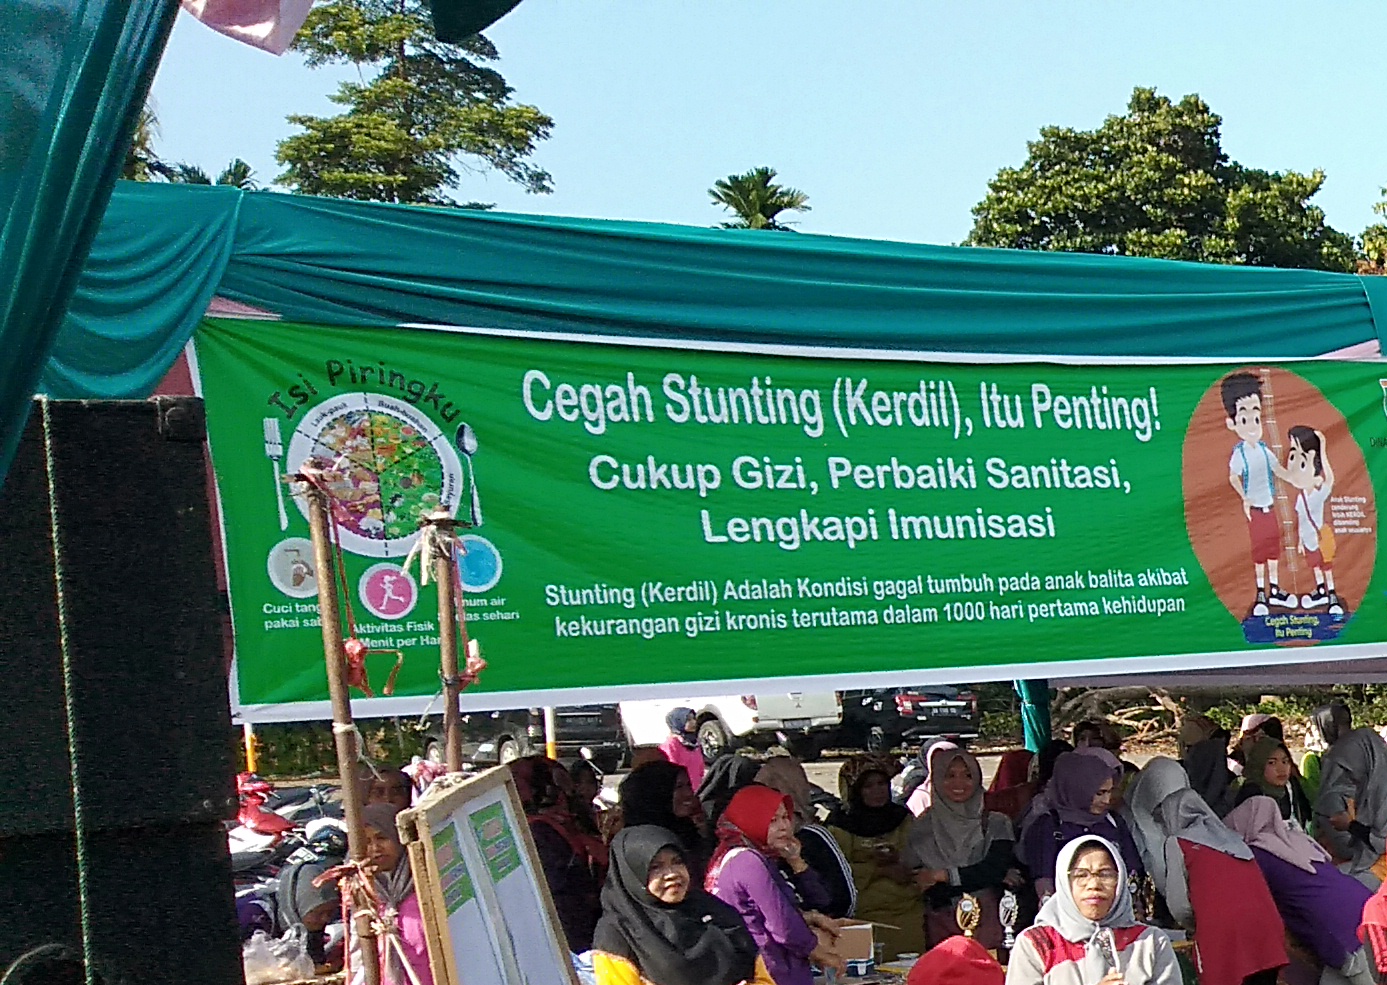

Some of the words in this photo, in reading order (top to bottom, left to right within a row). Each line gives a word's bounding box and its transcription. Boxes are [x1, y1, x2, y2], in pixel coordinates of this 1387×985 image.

[268, 374, 319, 420] Isi
[325, 359, 461, 423] Piringku
[522, 370, 655, 434] Cegah
[662, 373, 824, 438] Stunting
[833, 377, 974, 439] (Kerdil),
[980, 381, 1025, 428] Itu
[1031, 383, 1161, 442] Penting!
[588, 455, 721, 497] Cukup
[732, 456, 819, 495] Gizi,
[827, 456, 977, 489] Perbaiki
[985, 457, 1131, 494] Sanitasi,
[700, 509, 879, 550] Lengkapi
[888, 507, 1056, 541] Imunisasi
[490, 596, 507, 606] air
[545, 583, 635, 609] Stunting
[641, 580, 718, 607] (Kerdil)
[723, 578, 793, 601] Adalah
[797, 576, 868, 599] Kondisi
[873, 575, 923, 600] gagal
[927, 573, 994, 595] tumbuh
[999, 571, 1041, 596] pada
[1045, 570, 1085, 590] anak
[1088, 568, 1135, 589] balita
[1138, 567, 1189, 587] akibat
[263, 602, 293, 614] Cuci
[483, 609, 520, 621] sehari
[555, 615, 680, 639] kekurangan
[685, 611, 721, 637] gizi
[726, 609, 788, 632] kronis
[792, 606, 880, 628] terutama
[883, 603, 938, 625] dalam
[943, 601, 986, 622] 1000
[989, 599, 1024, 620] hari
[1028, 599, 1100, 623] pertama
[1102, 595, 1186, 617] kehidupan
[264, 617, 300, 631] pakai
[353, 621, 405, 634] Aktivitas
[406, 620, 435, 632] Fisik
[359, 637, 395, 649] Menit
[397, 638, 418, 649] per
